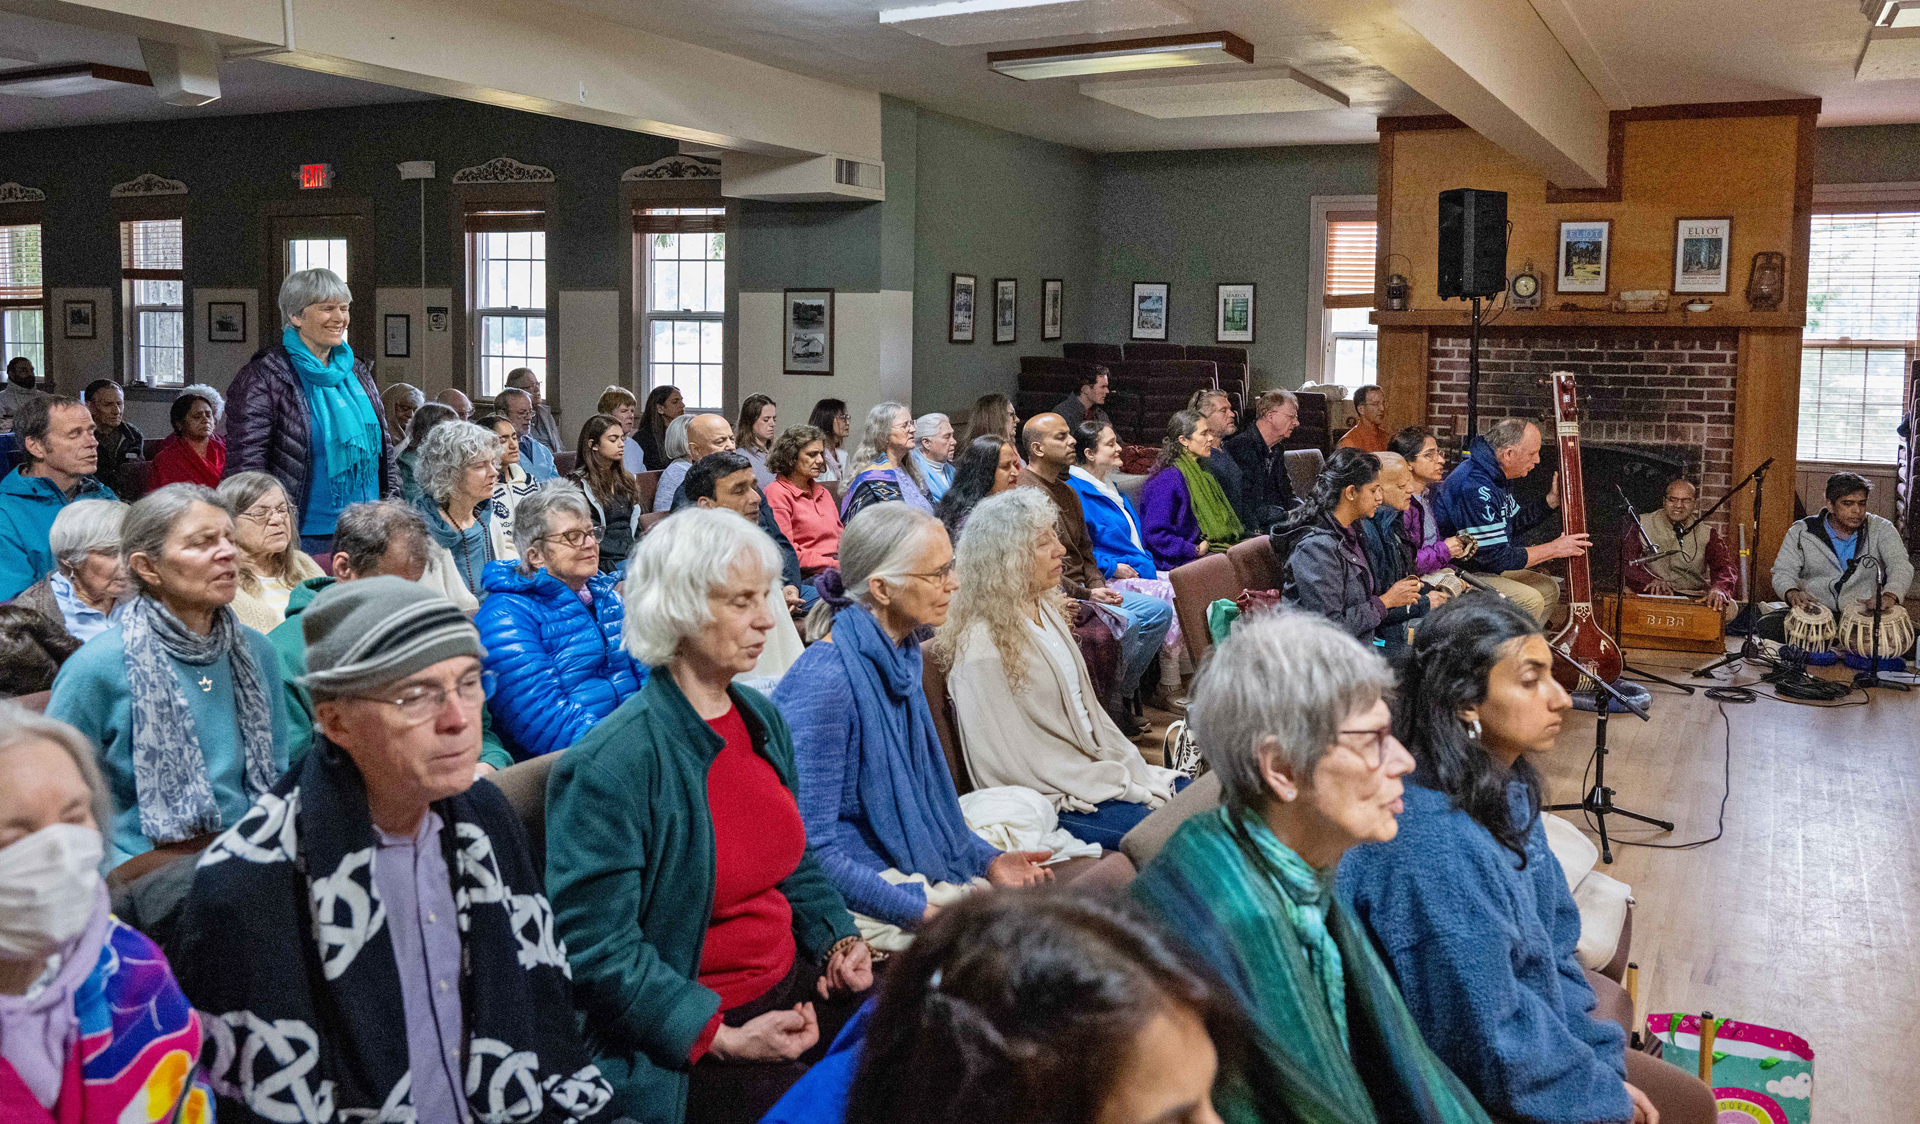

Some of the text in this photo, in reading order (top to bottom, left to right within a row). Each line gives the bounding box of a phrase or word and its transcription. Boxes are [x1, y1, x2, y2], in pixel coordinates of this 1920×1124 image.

[304, 164, 323, 187] EXIT
[1569, 230, 1600, 238] ELIOT
[1688, 227, 1719, 235] ELIOT
[1720, 1101, 1762, 1117] OORAY!
